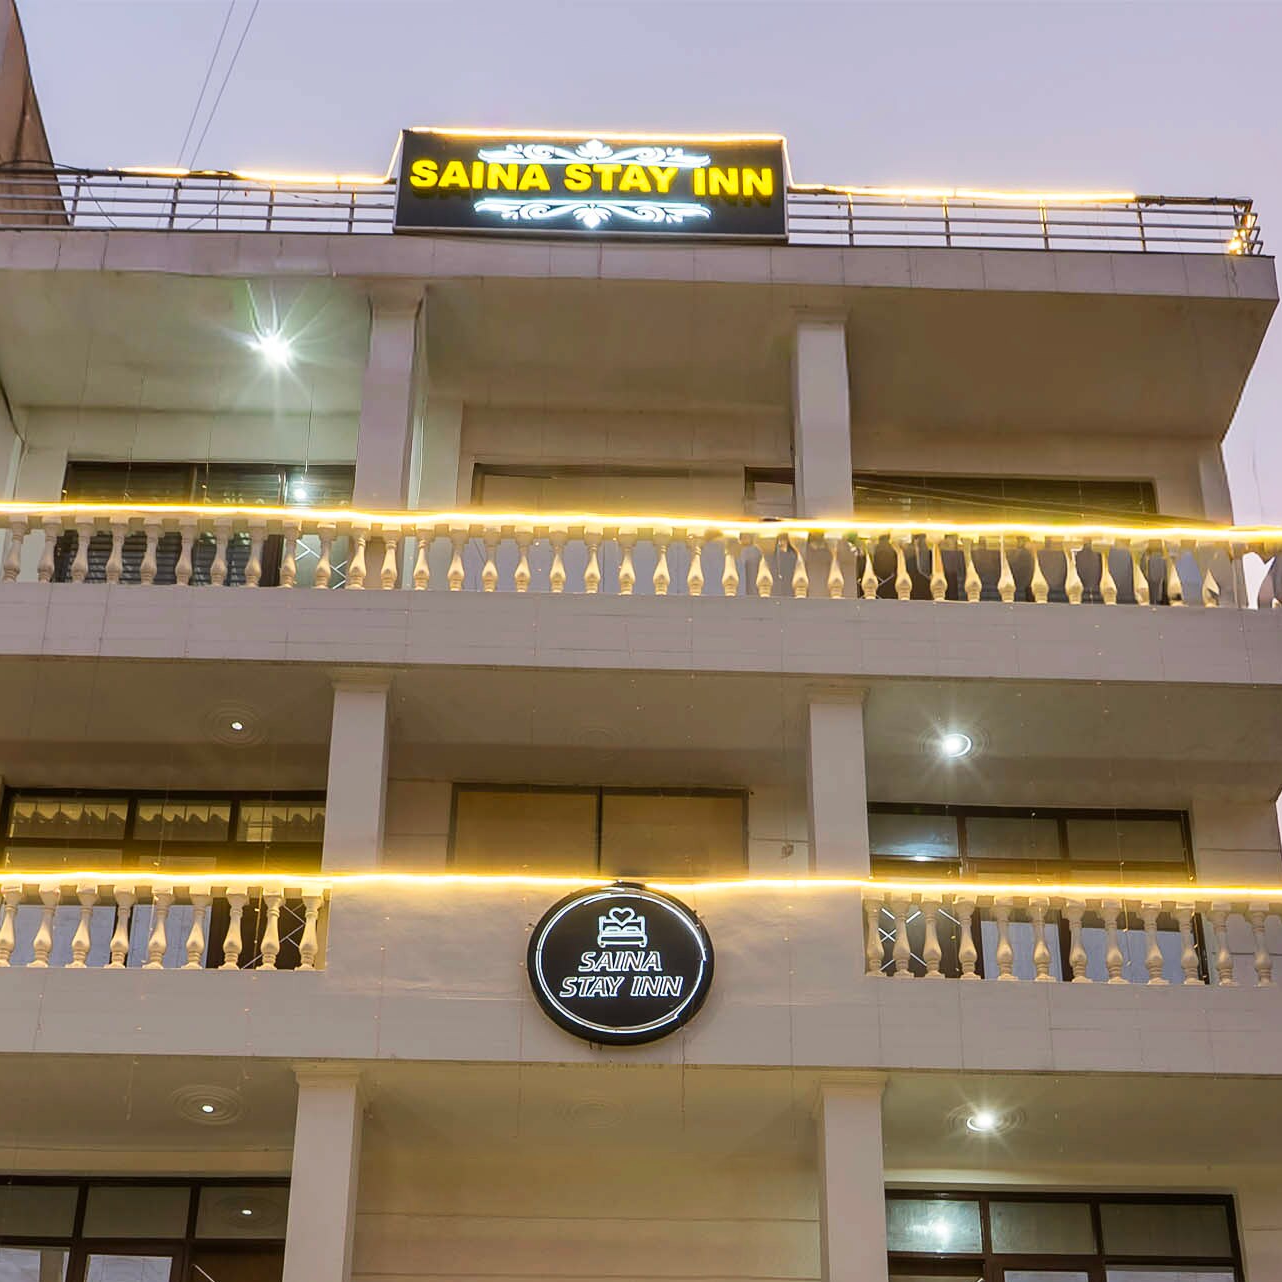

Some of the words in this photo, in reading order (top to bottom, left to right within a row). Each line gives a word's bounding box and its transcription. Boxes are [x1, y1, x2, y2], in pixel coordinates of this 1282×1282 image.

[409, 158, 551, 192] SAINA
[563, 163, 679, 194] STAY
[692, 166, 774, 197] INN
[578, 950, 663, 973] SAINA
[559, 976, 626, 998] STAY
[630, 975, 684, 997] INN
